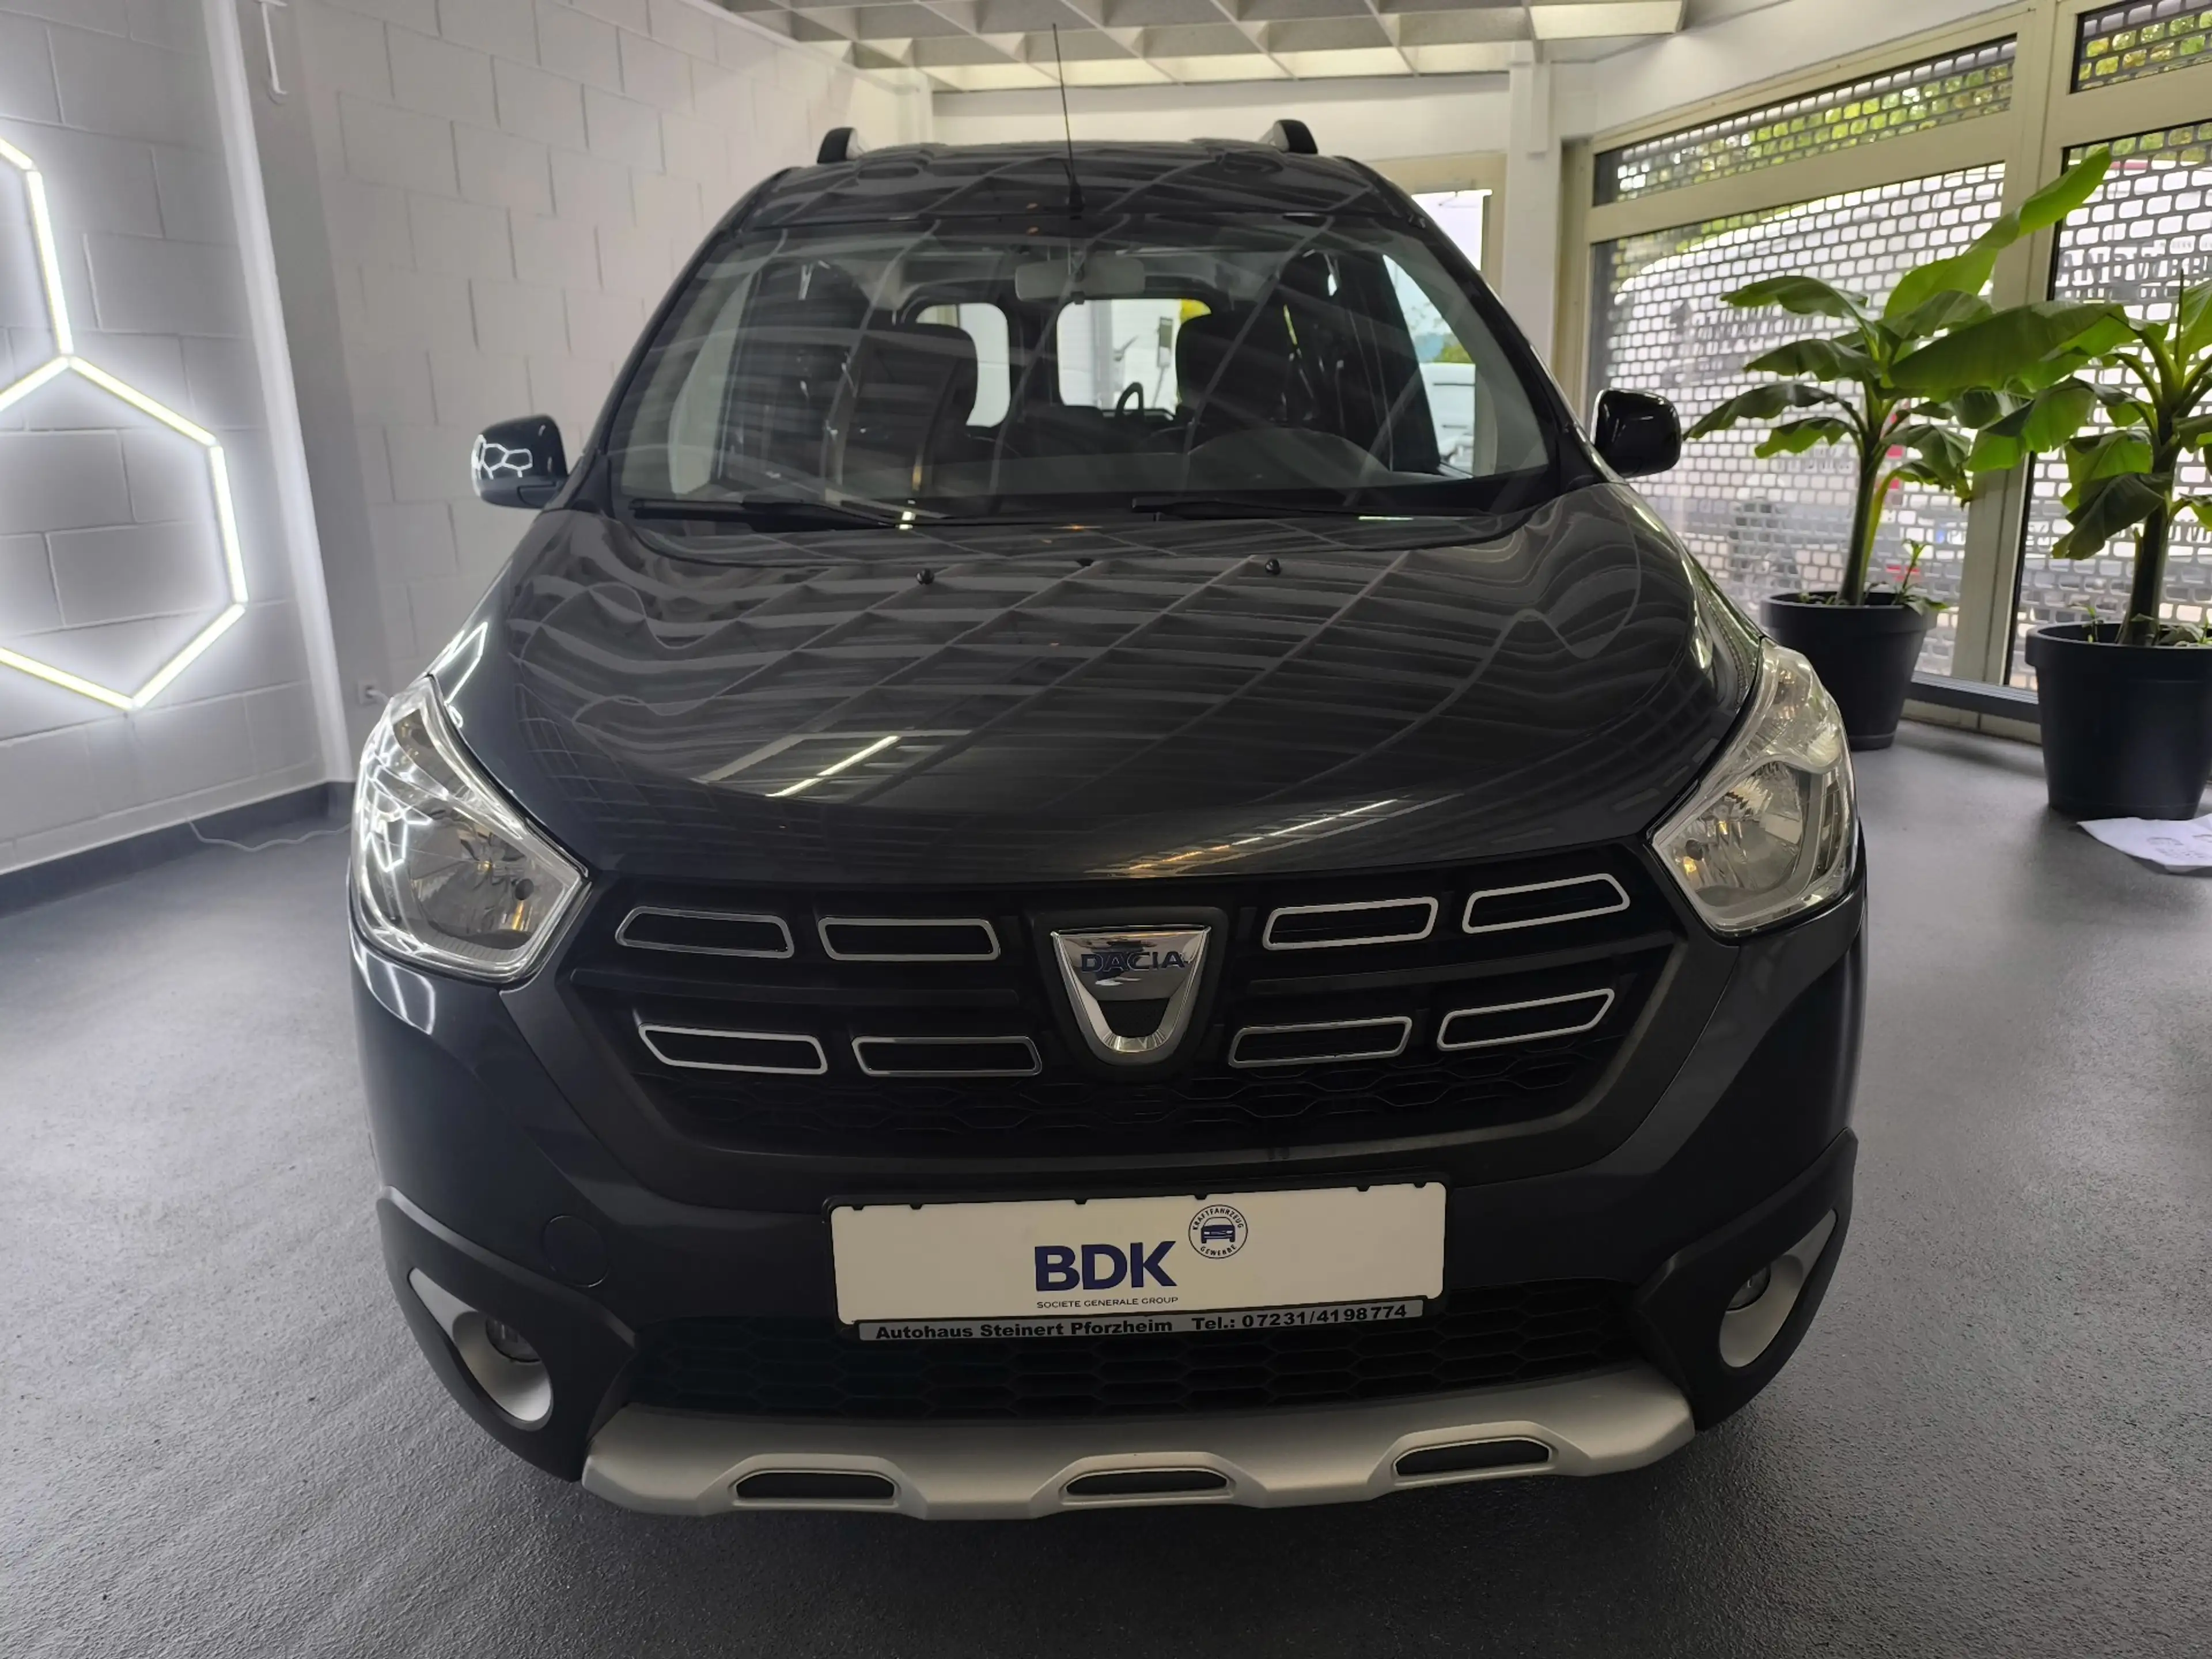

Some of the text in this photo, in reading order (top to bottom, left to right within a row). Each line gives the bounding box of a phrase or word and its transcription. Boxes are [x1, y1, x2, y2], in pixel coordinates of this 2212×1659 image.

[1081, 951, 1185, 972] DACIA
[1192, 1207, 1244, 1230] KRAFTFAHRZEUG
[1200, 1244, 1237, 1256] GEWERBE
[1035, 1240, 1178, 1291] BDK
[1037, 1296, 1179, 1309] SOCIETE GENERALE GROUP
[876, 1304, 1407, 1339] Autohaus Steinert Pforzheim Tel.: 07231/4198774
